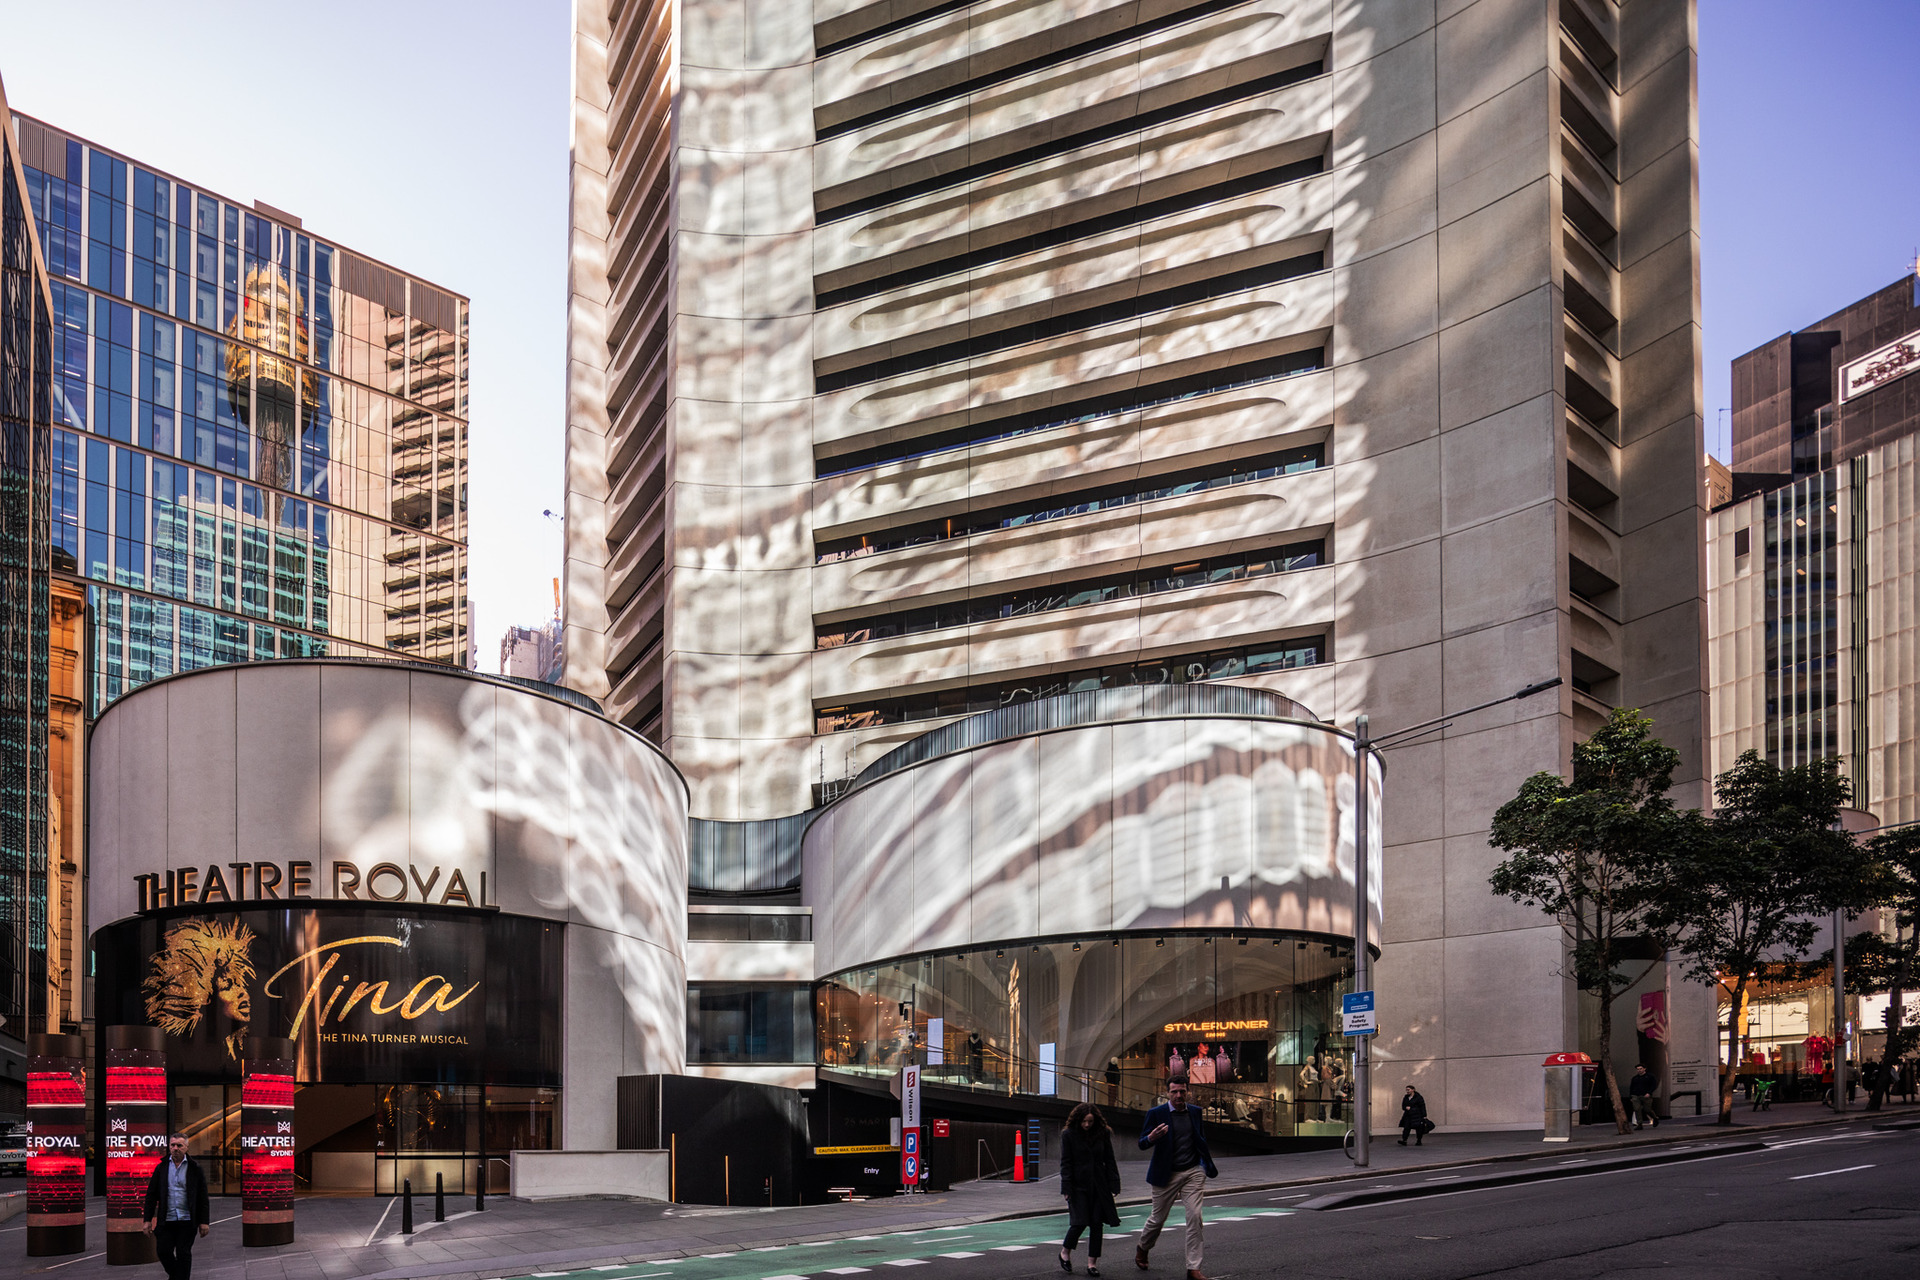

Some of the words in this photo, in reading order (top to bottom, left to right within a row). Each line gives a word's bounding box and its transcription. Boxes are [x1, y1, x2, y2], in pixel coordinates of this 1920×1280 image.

[133, 860, 312, 914] THEATRE
[332, 860, 500, 912] ROYAL
[264, 935, 479, 1042] Tina
[1164, 1020, 1269, 1032] STYLERUNNER
[317, 1033, 338, 1043] THE
[342, 1033, 368, 1043] TINA
[371, 1033, 417, 1044] TURNER
[420, 1034, 469, 1045] MUSICAL
[34, 1136, 80, 1147] ROYAL
[131, 1135, 168, 1147] ROYAL
[241, 1136, 290, 1148] THEATRE
[908, 1137, 914, 1149] P
[107, 1150, 135, 1158] SYDNEY
[864, 1167, 880, 1175] Entry
